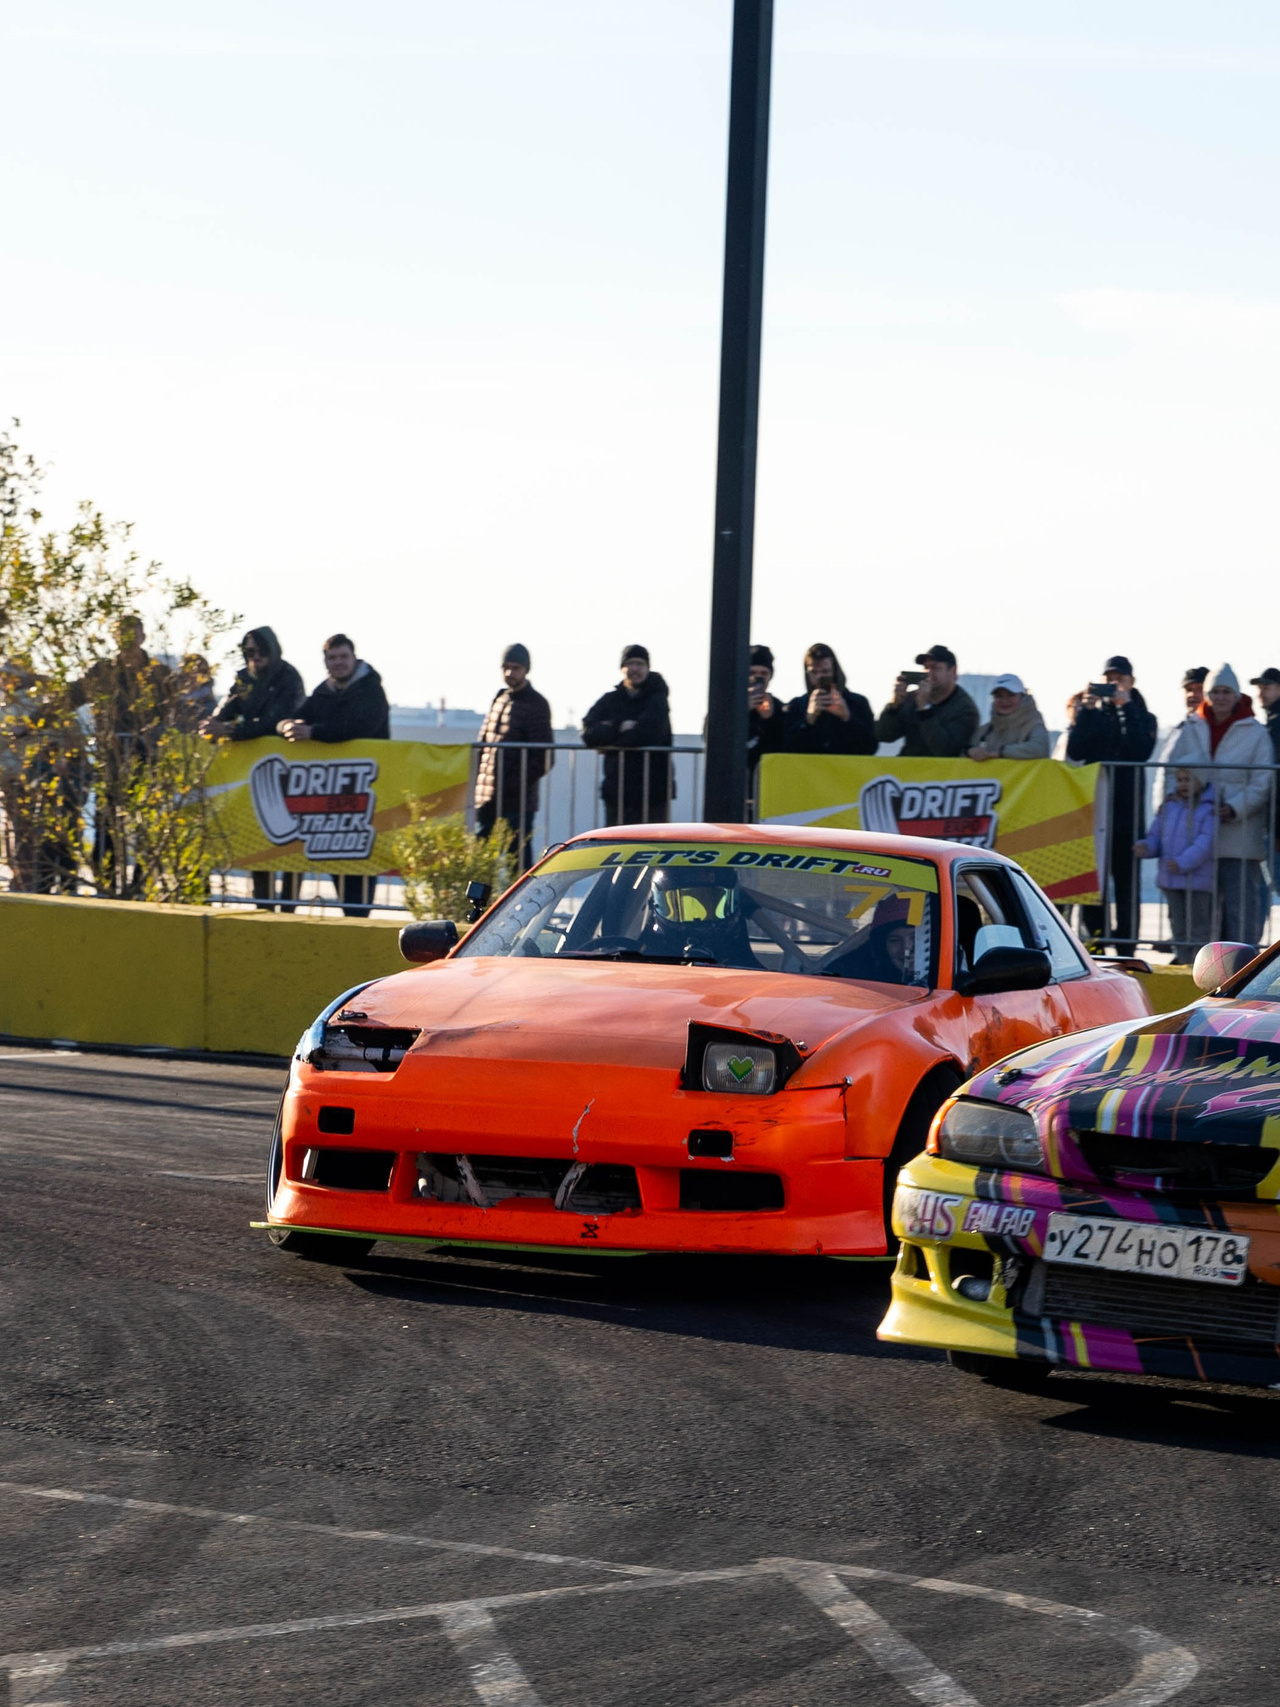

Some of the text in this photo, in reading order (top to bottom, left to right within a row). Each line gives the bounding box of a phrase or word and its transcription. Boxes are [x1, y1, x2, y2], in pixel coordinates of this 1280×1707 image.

[287, 765, 371, 796] DRIFT
[900, 787, 994, 819] DRIFT
[600, 850, 720, 866] LET'S
[845, 884, 927, 927] 71
[1187, 1234, 1239, 1266] 178
[1193, 1265, 1219, 1278] RUS
